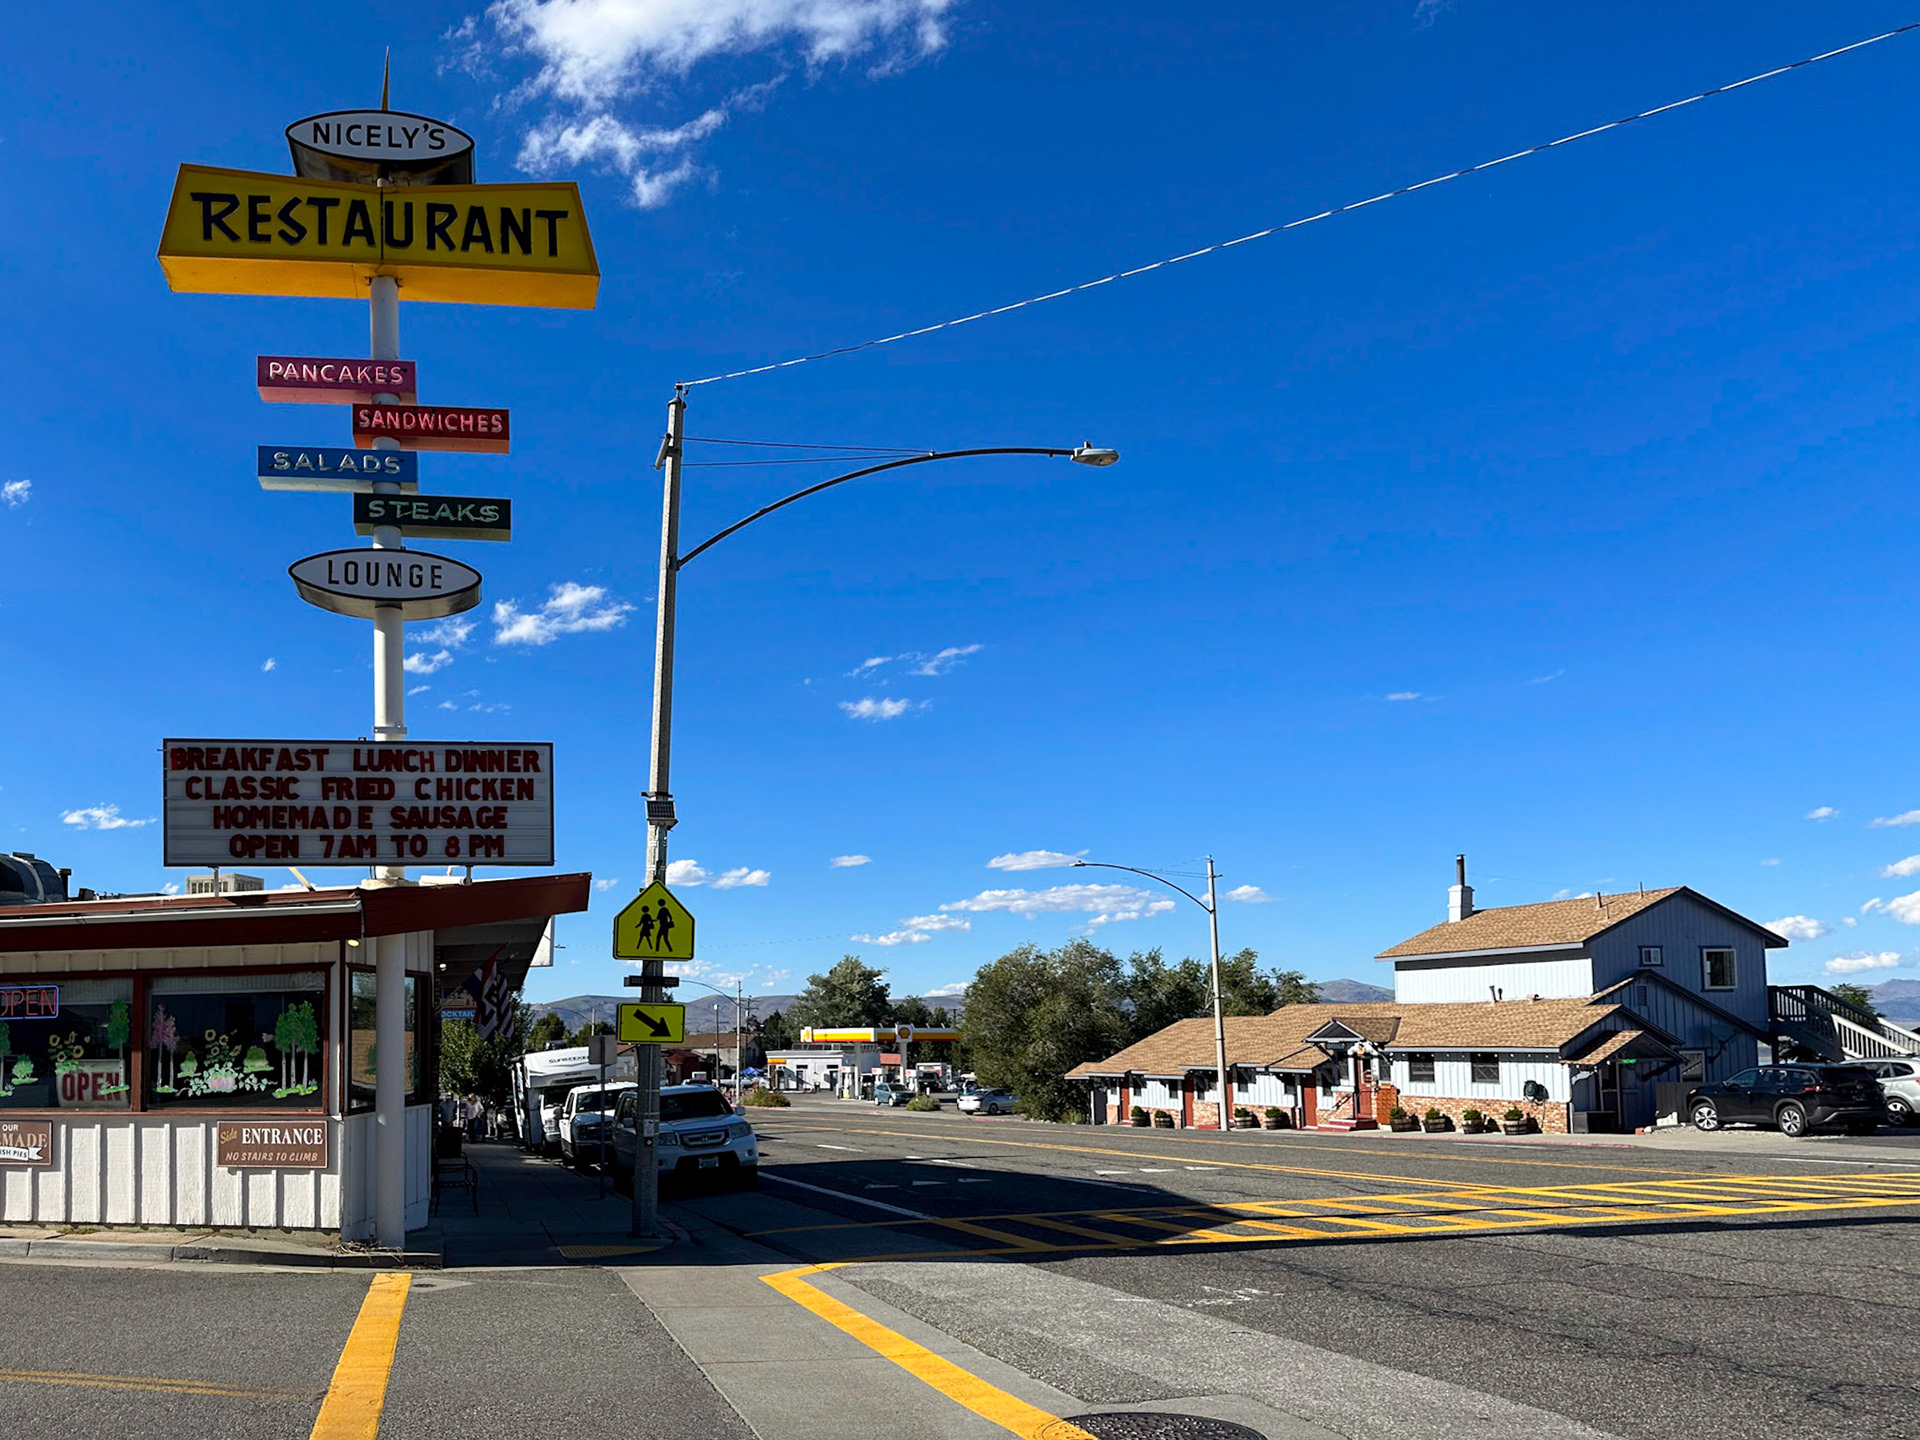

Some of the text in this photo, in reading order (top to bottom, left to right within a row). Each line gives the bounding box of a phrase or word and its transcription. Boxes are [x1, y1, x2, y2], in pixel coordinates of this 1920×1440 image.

[312, 122, 447, 151] NICELY'S
[190, 191, 569, 257] RESTAURANT
[268, 361, 404, 385] PANCAKES
[358, 408, 503, 434] SANDWICHES
[272, 451, 402, 475] SALADS
[368, 500, 500, 523] STEAKS
[327, 559, 443, 589] LOUNGE
[170, 747, 541, 773] BREAKFAST LUNCH DINNER
[185, 776, 534, 801] CLASSIC FRIED CHICKEN
[213, 805, 508, 829] HOMEMADE SAUSAGE
[229, 834, 504, 858] OPEN 7AM TO 8 PM
[62, 1072, 122, 1102] OPEN
[2, 1123, 19, 1132] OUR
[220, 1127, 324, 1146] Side ENTRANCE
[0, 1133, 48, 1148] MADE
[13, 1150, 28, 1159] PIES
[225, 1152, 319, 1162] NO STAIRS TO CLIMB
